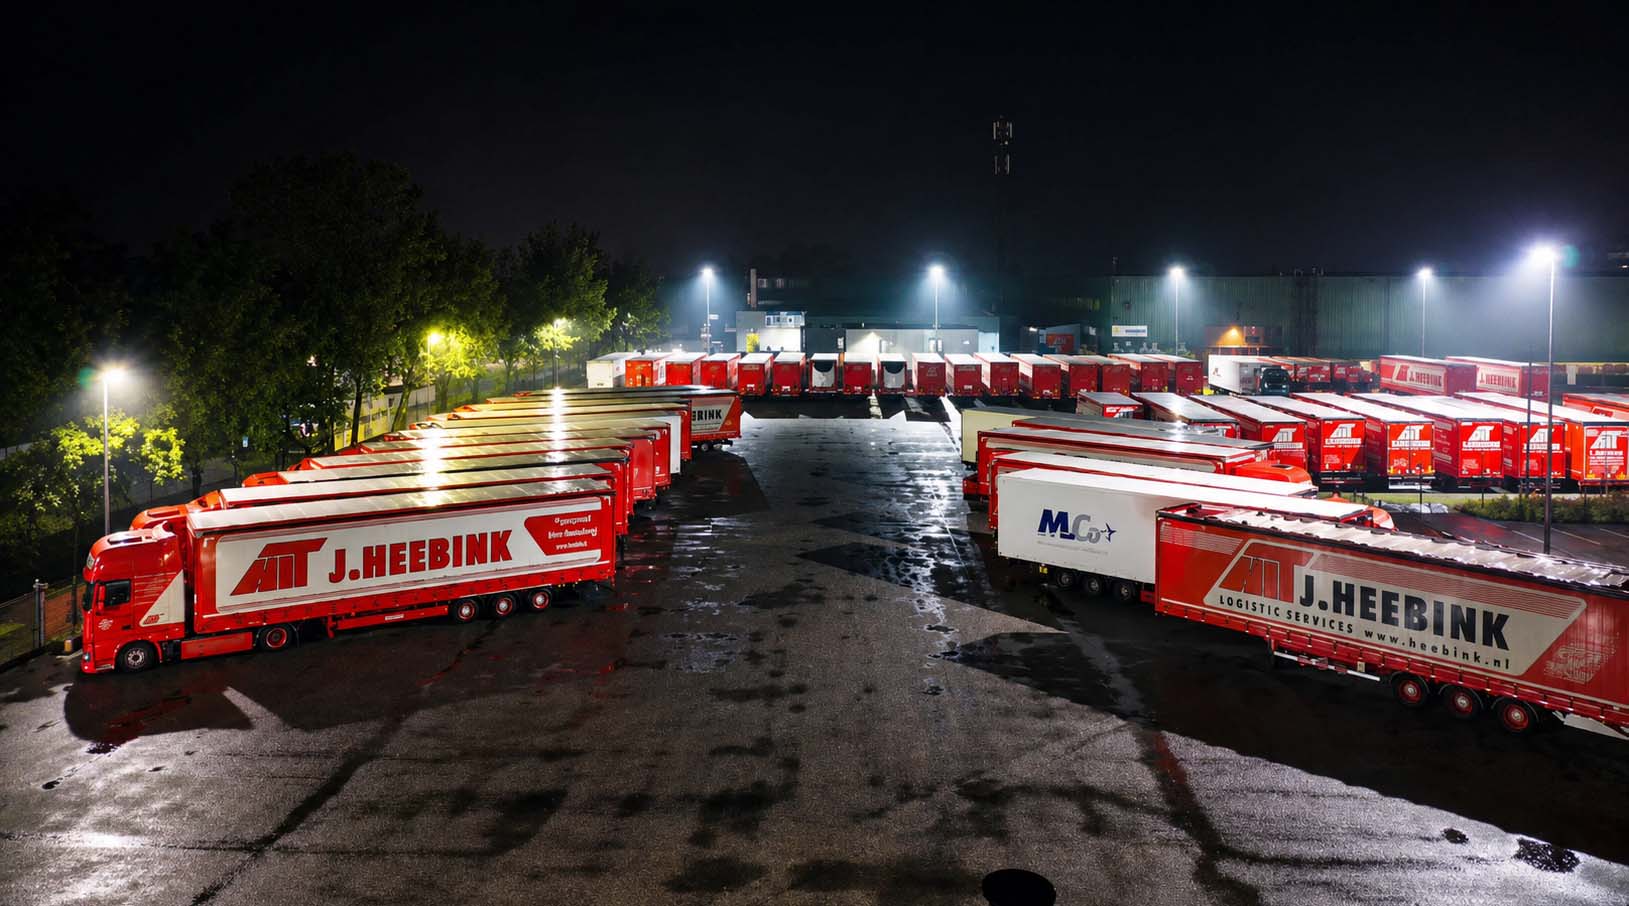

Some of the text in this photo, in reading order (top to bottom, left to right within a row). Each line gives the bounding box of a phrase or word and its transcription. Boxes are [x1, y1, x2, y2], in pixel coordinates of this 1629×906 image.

[329, 530, 512, 584] J.HEEBINK
[1219, 595, 1510, 669] LOGISTIC SERVICES www.heebink.nl
[1300, 574, 1510, 651] J.HEEBINK
